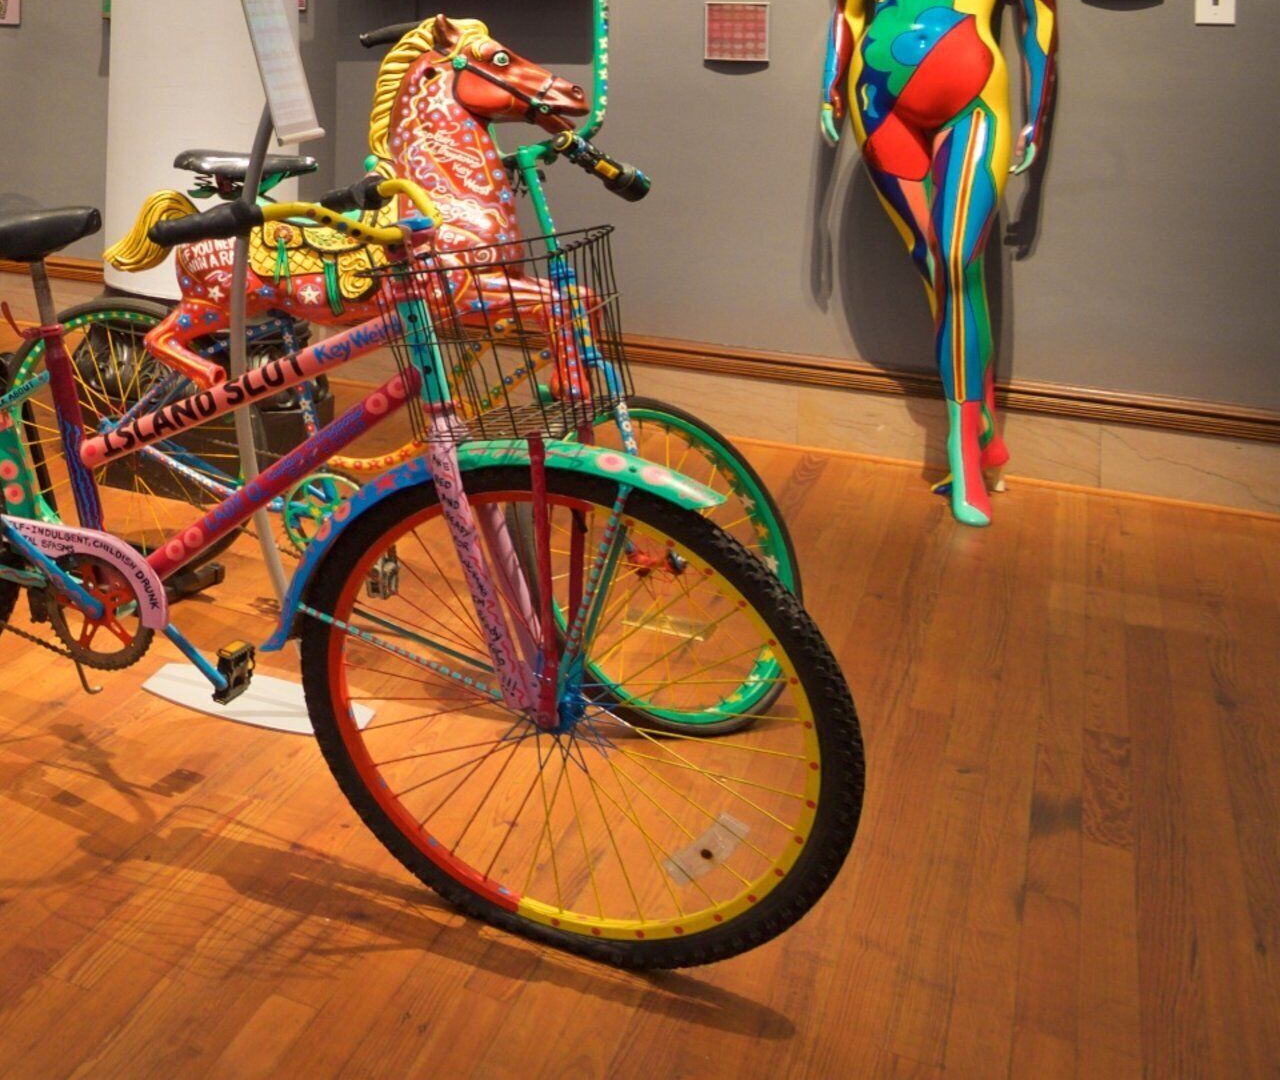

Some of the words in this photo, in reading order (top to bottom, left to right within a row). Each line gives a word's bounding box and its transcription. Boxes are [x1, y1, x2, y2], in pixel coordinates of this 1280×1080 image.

[191, 240, 212, 257] YOU
[209, 253, 220, 268] A
[8, 382, 35, 402] ABOUT
[102, 390, 216, 458] ISLAND
[223, 353, 305, 406] SLUT
[313, 339, 351, 365] Key
[11, 521, 94, 547] LF-INDULGENT,
[92, 539, 138, 570] CHILDISH
[135, 570, 160, 610] DRUNK
